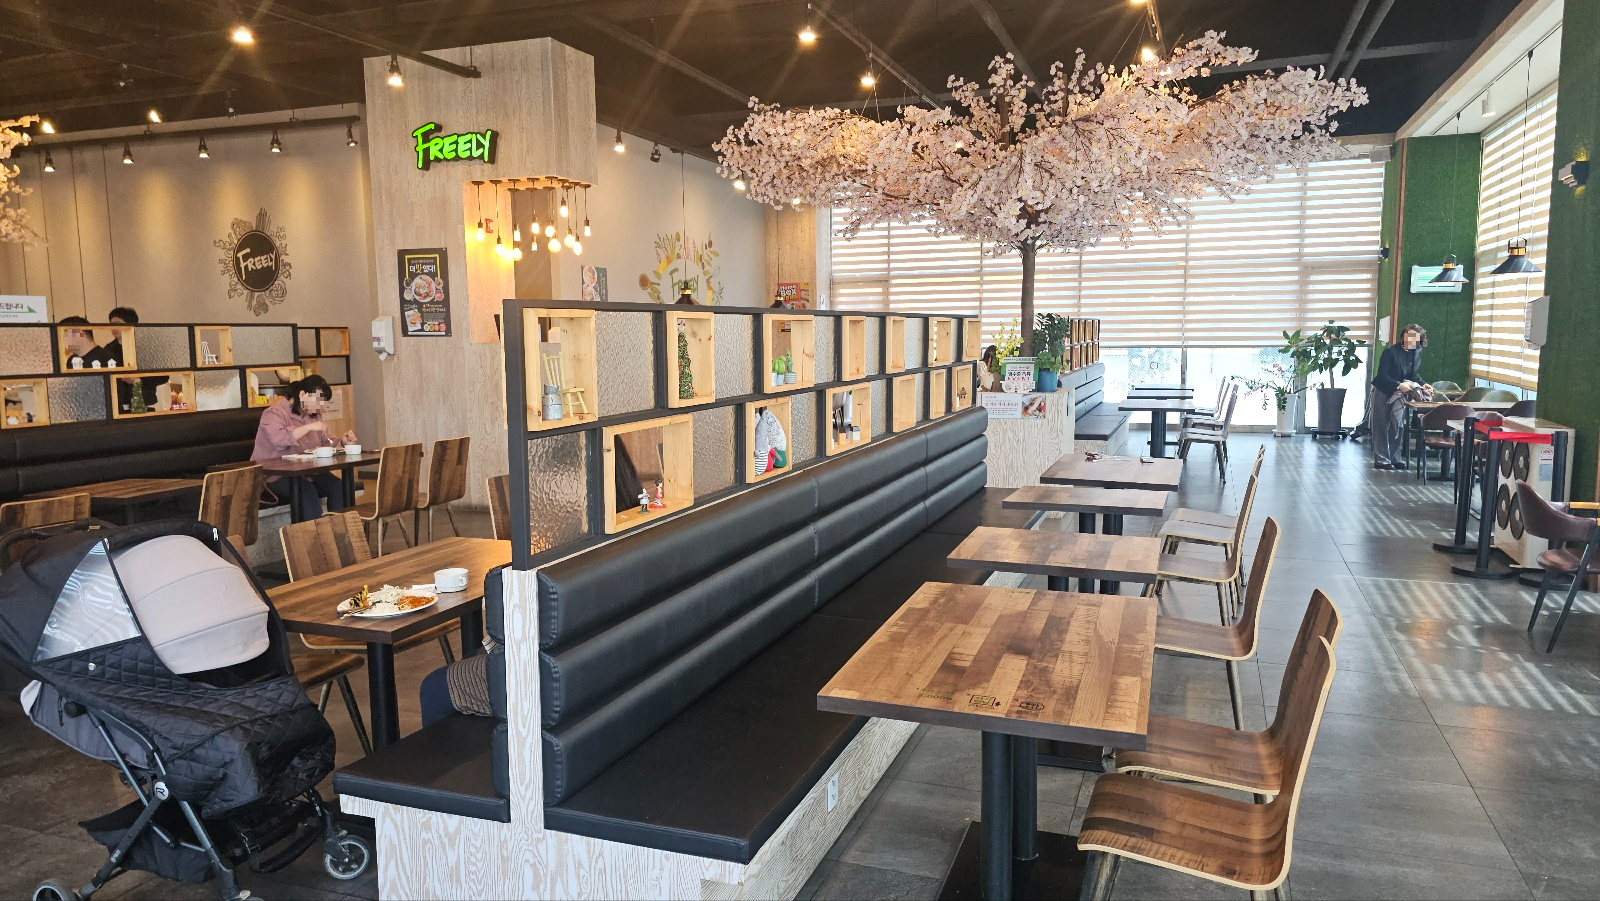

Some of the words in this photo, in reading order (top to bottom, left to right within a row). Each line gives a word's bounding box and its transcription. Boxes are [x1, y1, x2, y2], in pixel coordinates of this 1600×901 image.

[412, 122, 495, 170] FREELY
[237, 247, 276, 281] FREELY
[669, 267, 700, 301] FRELY
